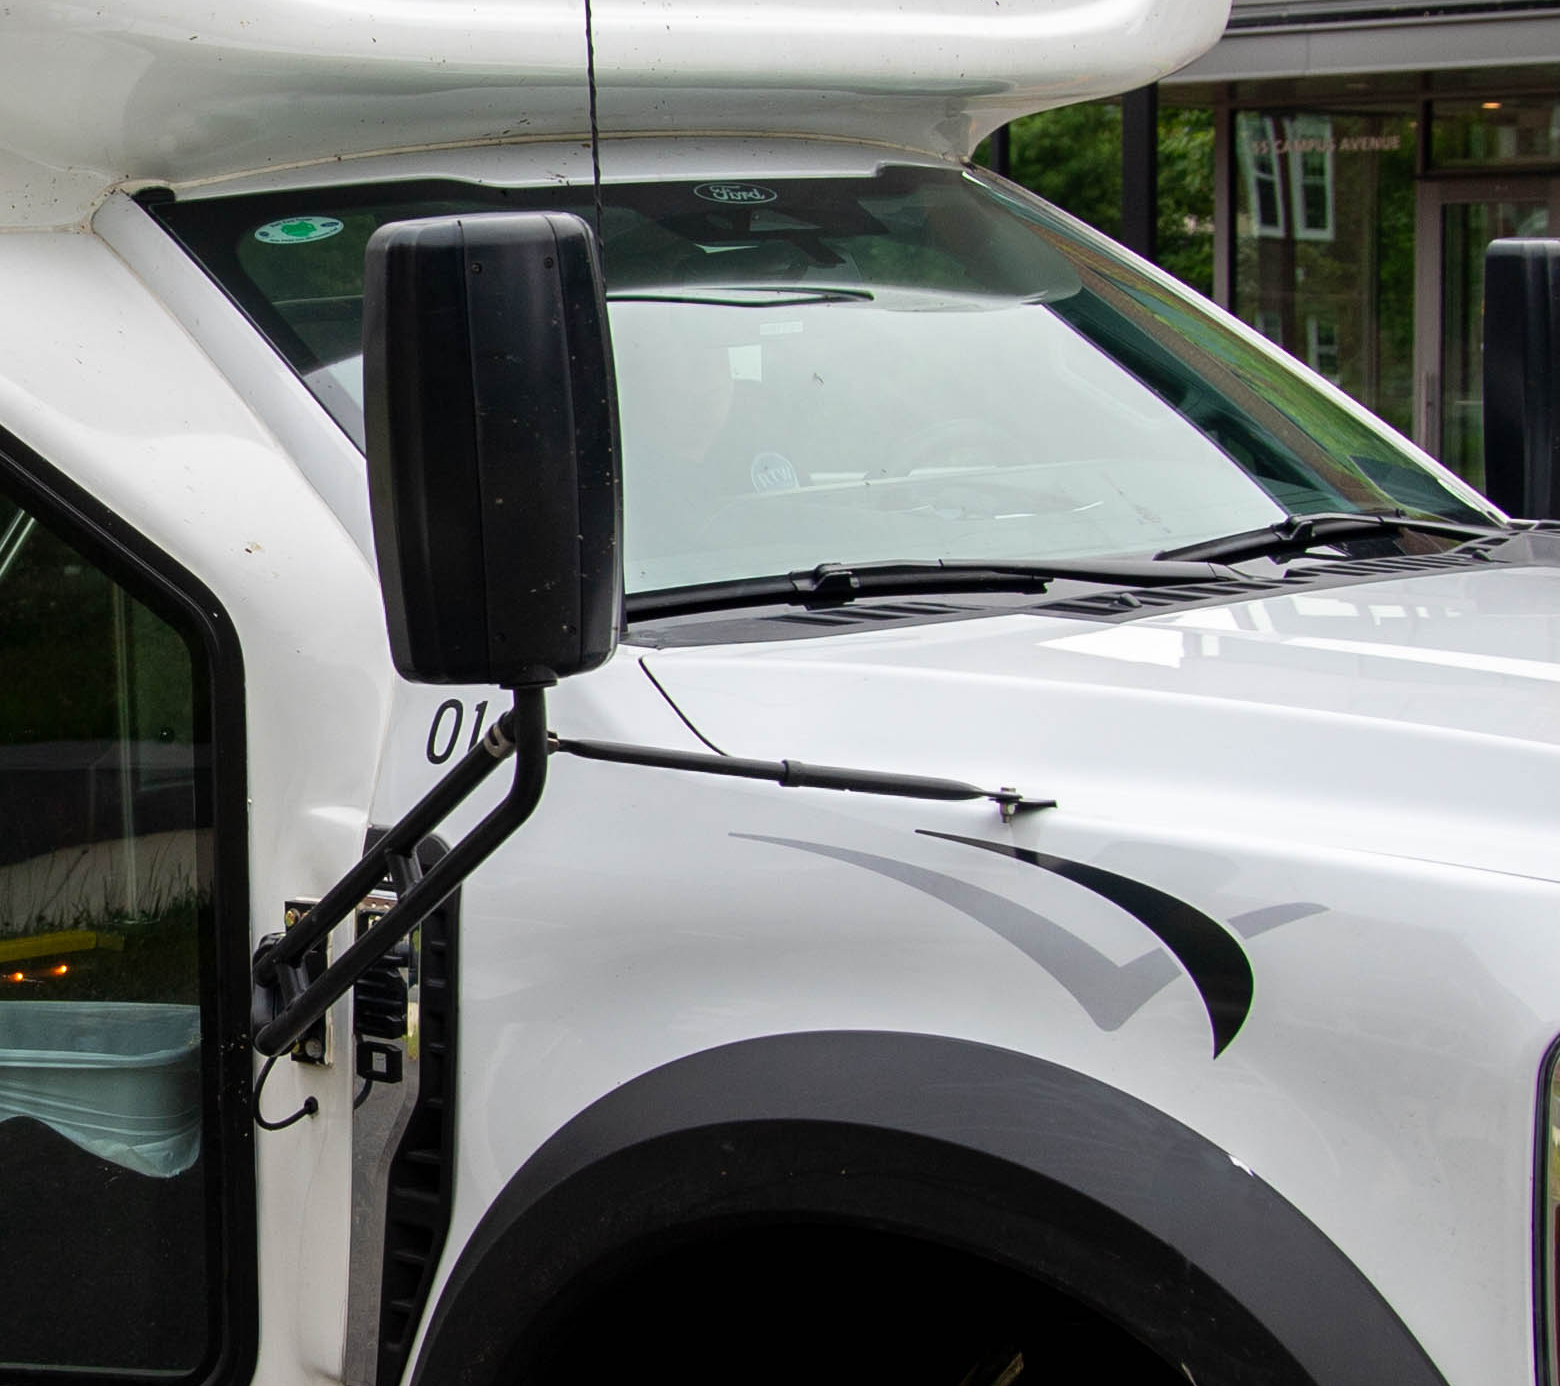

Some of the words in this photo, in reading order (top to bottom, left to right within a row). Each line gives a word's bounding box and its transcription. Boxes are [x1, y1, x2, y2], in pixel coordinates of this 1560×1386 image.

[1275, 137, 1336, 154] CAMPUS
[1339, 134, 1401, 151] AVENUE
[709, 185, 766, 201] Ford
